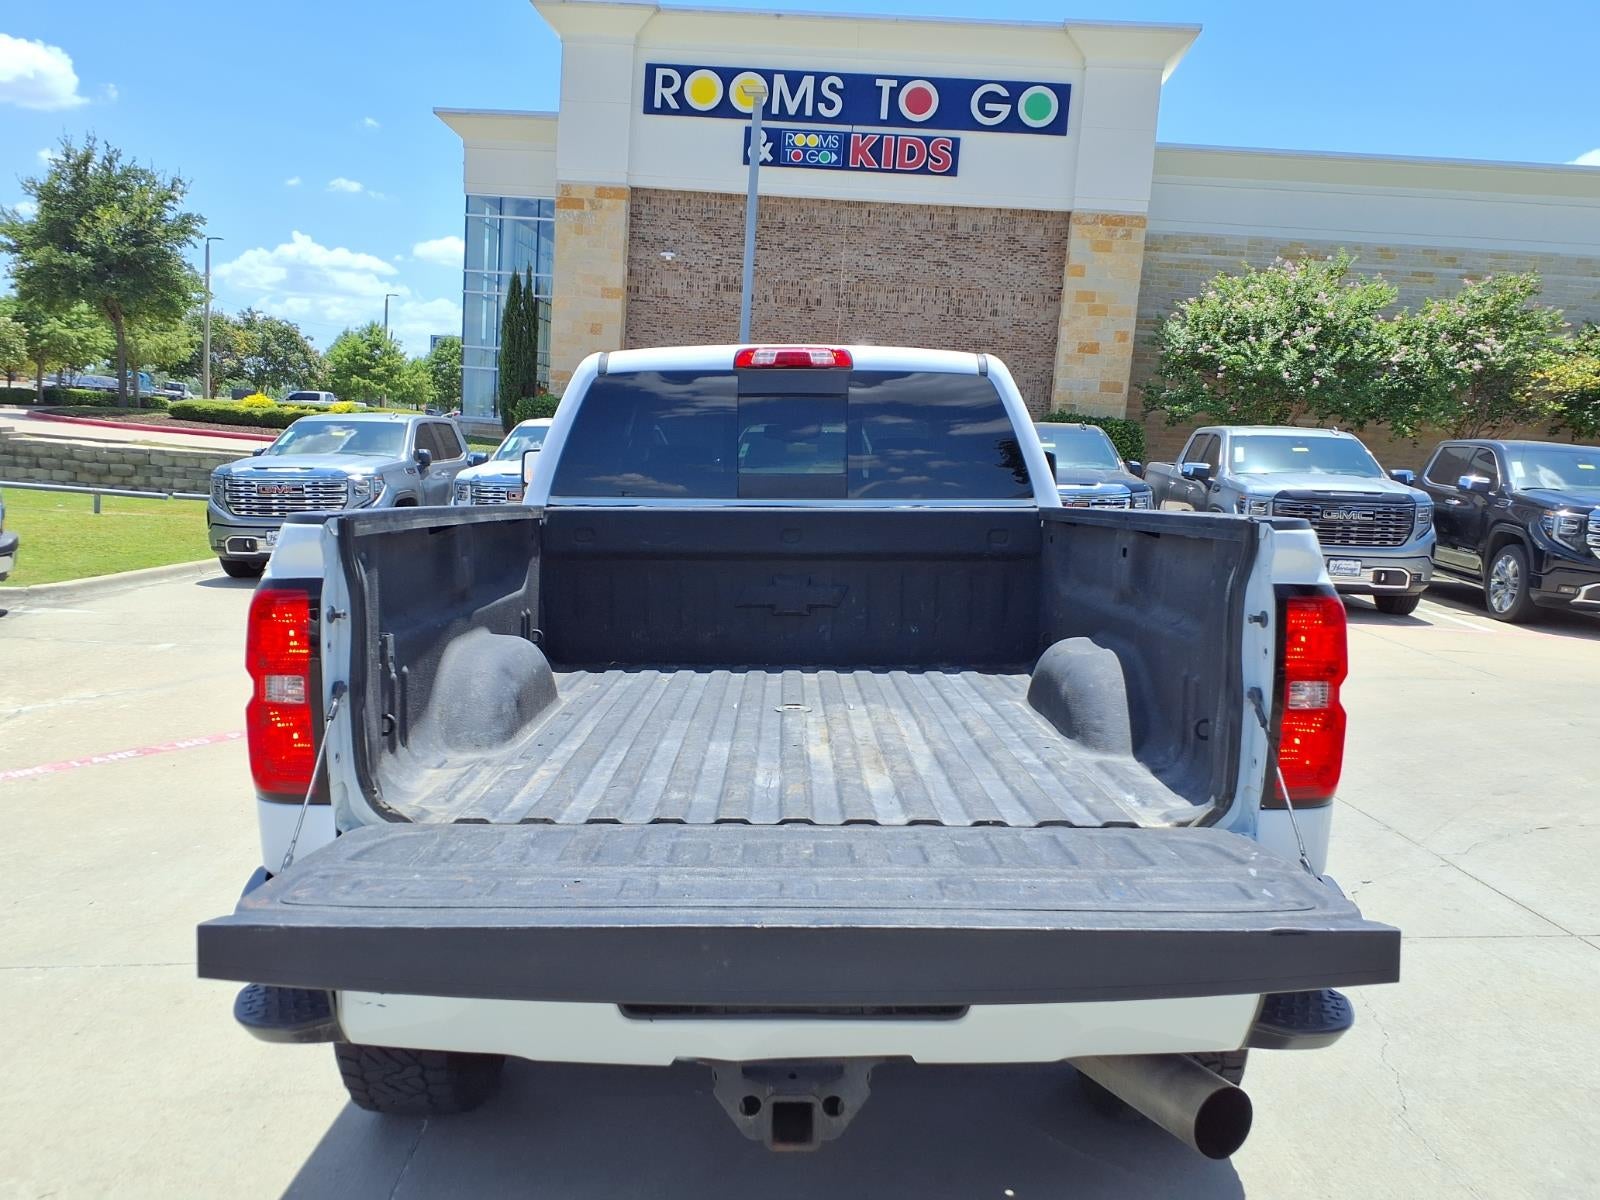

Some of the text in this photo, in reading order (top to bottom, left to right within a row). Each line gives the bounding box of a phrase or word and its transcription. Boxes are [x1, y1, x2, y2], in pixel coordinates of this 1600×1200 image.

[653, 67, 1059, 128] ROOMS TO GO
[785, 132, 839, 148] ROOMS
[785, 149, 831, 164] TO GO
[849, 133, 953, 173] KIDS
[259, 485, 302, 494] GMC
[1322, 510, 1374, 520] GMC
